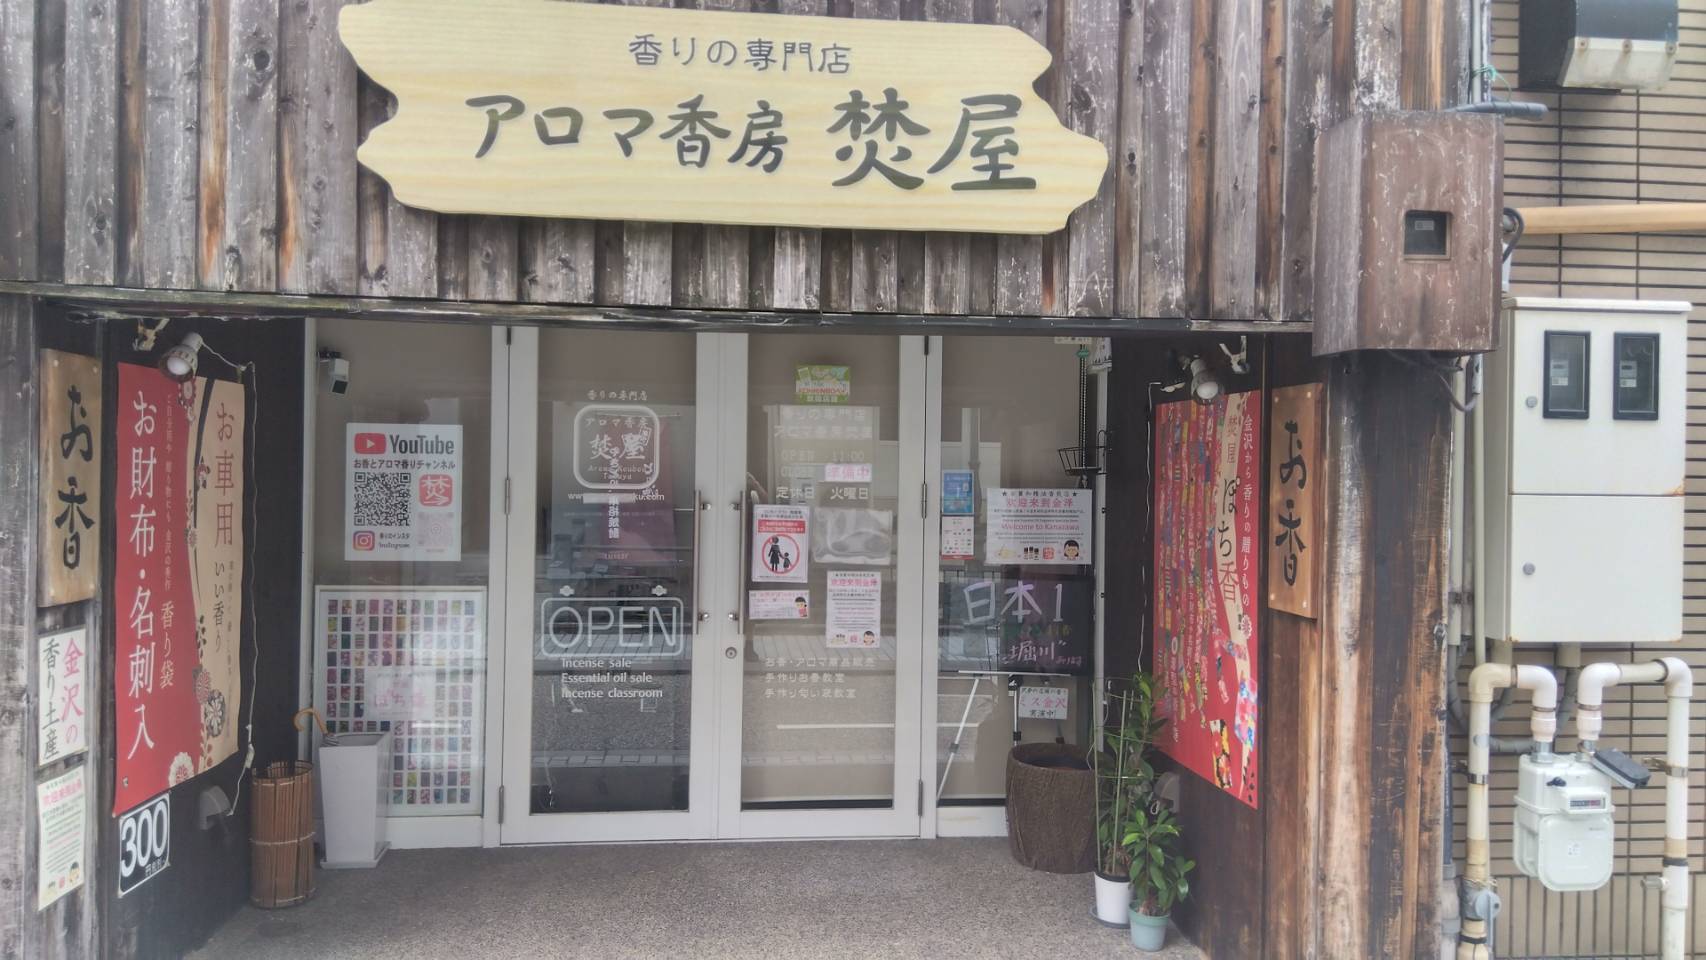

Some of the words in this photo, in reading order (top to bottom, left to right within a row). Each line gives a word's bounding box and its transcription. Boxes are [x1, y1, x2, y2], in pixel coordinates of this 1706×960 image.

[628, 34, 852, 74] 香りの専門店
[466, 94, 789, 173] アロマ香房
[827, 89, 1038, 190] 焚屋
[587, 390, 648, 401] 香りの専門店
[354, 459, 455, 470] お香とアロマ香りチャンネル
[390, 434, 455, 455] YouTube
[1227, 415, 1238, 464] 焚屋
[54, 385, 95, 569] お香
[214, 402, 235, 547] お車用
[776, 486, 815, 499] 定休日
[830, 487, 869, 500] 火曜日
[1275, 420, 1307, 586] お香
[1218, 477, 1240, 603] ぽち香
[128, 390, 157, 760] お財布・名刺入
[213, 561, 225, 653] いい香り
[549, 606, 677, 648] OPEN
[160, 602, 175, 688] 香り袋
[561, 658, 604, 668] Incense
[609, 658, 632, 668] sale
[42, 638, 61, 761] 香り土産
[61, 638, 85, 745] 金沢の
[561, 672, 610, 683] Essential
[613, 672, 627, 683] oil
[630, 672, 653, 683] sale
[561, 687, 604, 698] Incense
[608, 687, 663, 698] classroom
[765, 673, 845, 683] 手作りお香教室
[122, 801, 168, 877] 300
